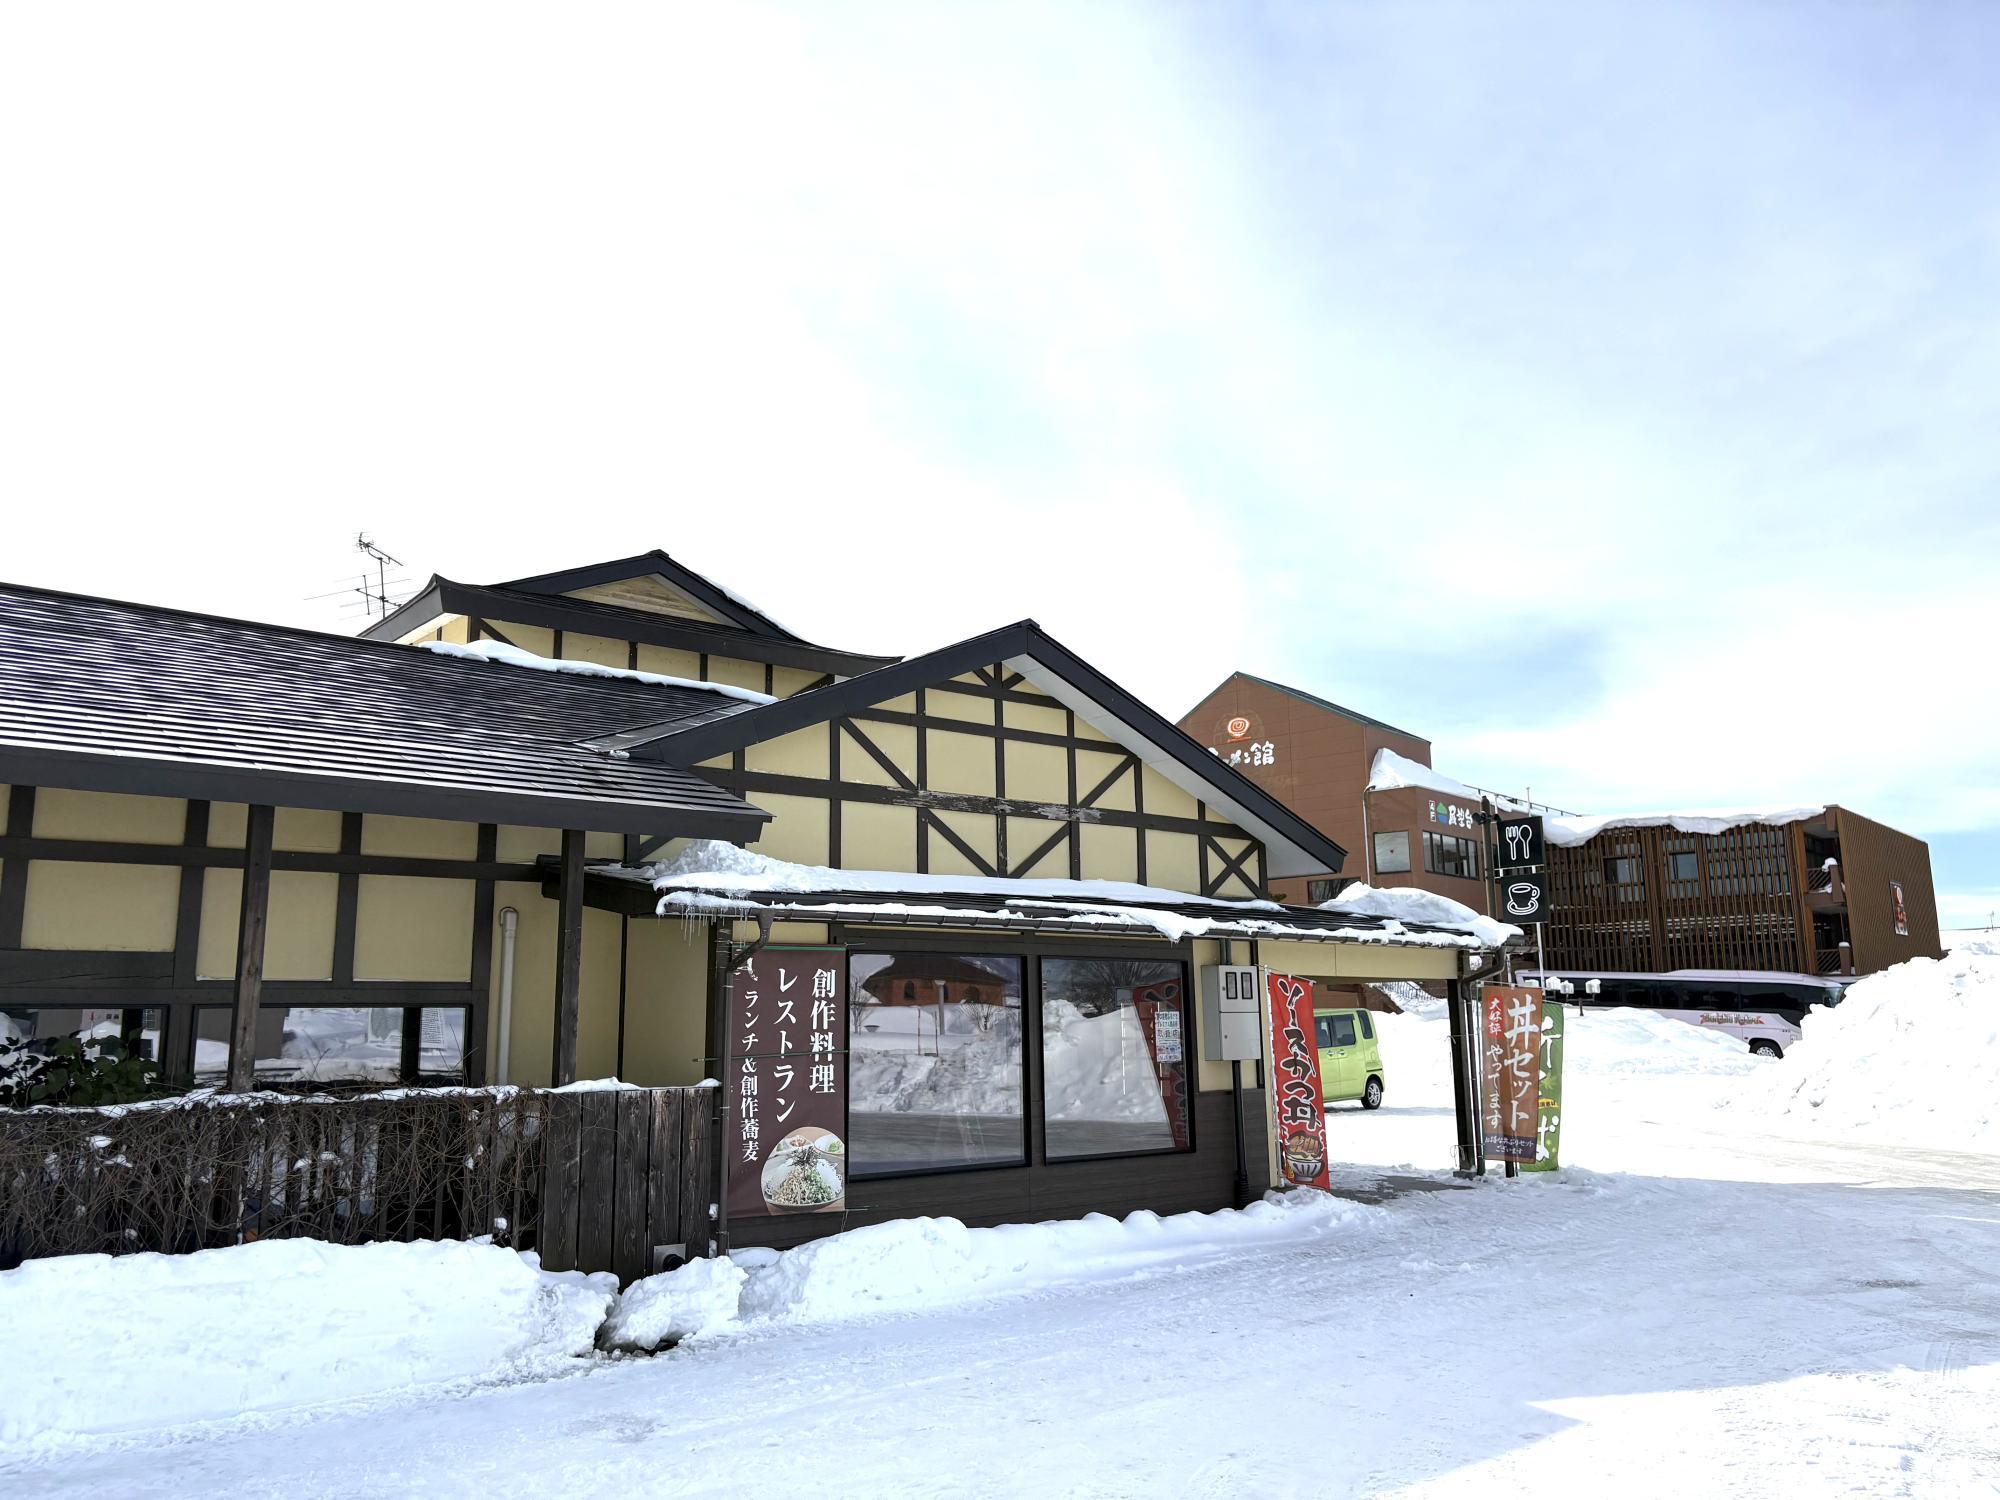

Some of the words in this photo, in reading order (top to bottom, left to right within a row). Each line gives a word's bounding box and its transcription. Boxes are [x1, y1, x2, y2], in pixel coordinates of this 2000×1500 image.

[773, 967, 798, 1124] レストラン
[808, 968, 836, 1094] 創作料理
[1488, 997, 1503, 1036] 大好評
[1503, 994, 1539, 1132] 丼セット
[1486, 1044, 1504, 1129] やってます
